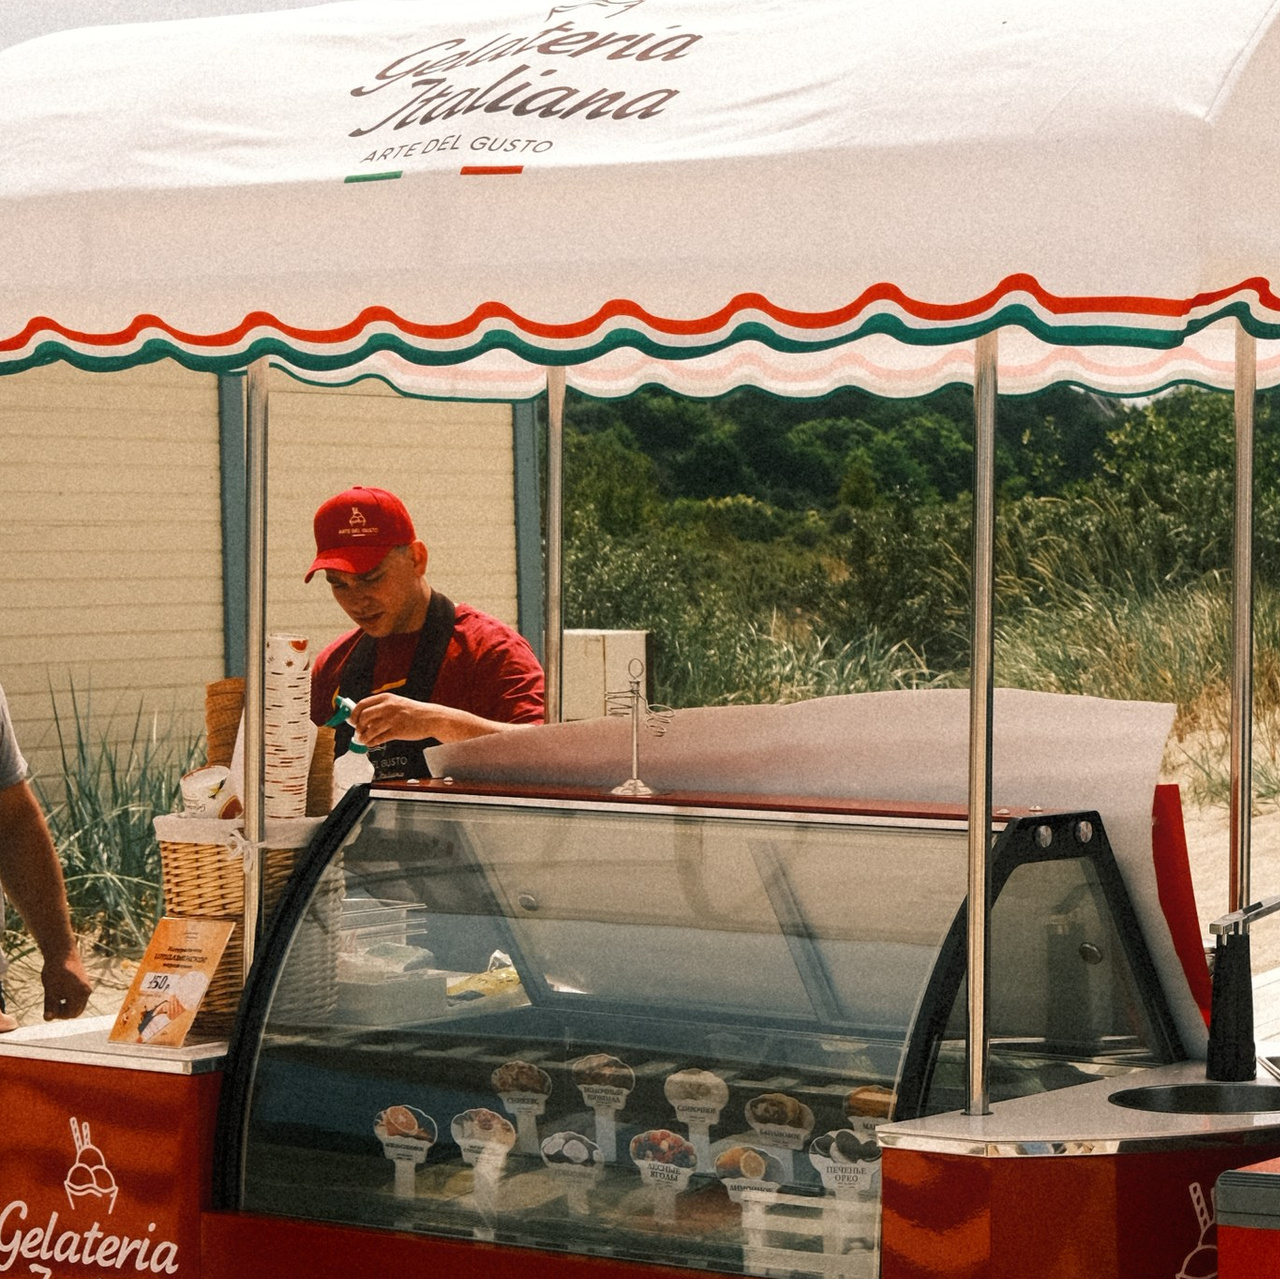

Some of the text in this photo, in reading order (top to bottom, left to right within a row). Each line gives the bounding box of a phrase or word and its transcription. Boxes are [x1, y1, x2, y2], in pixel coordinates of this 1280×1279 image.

[350, 21, 704, 97] Gelateria
[348, 64, 681, 138] Italiana
[359, 135, 554, 164] ARTE DEL GUSTO
[826, 1166, 867, 1175] ПЕЧЕНЬЕ
[0, 1200, 179, 1274] Gelateria
